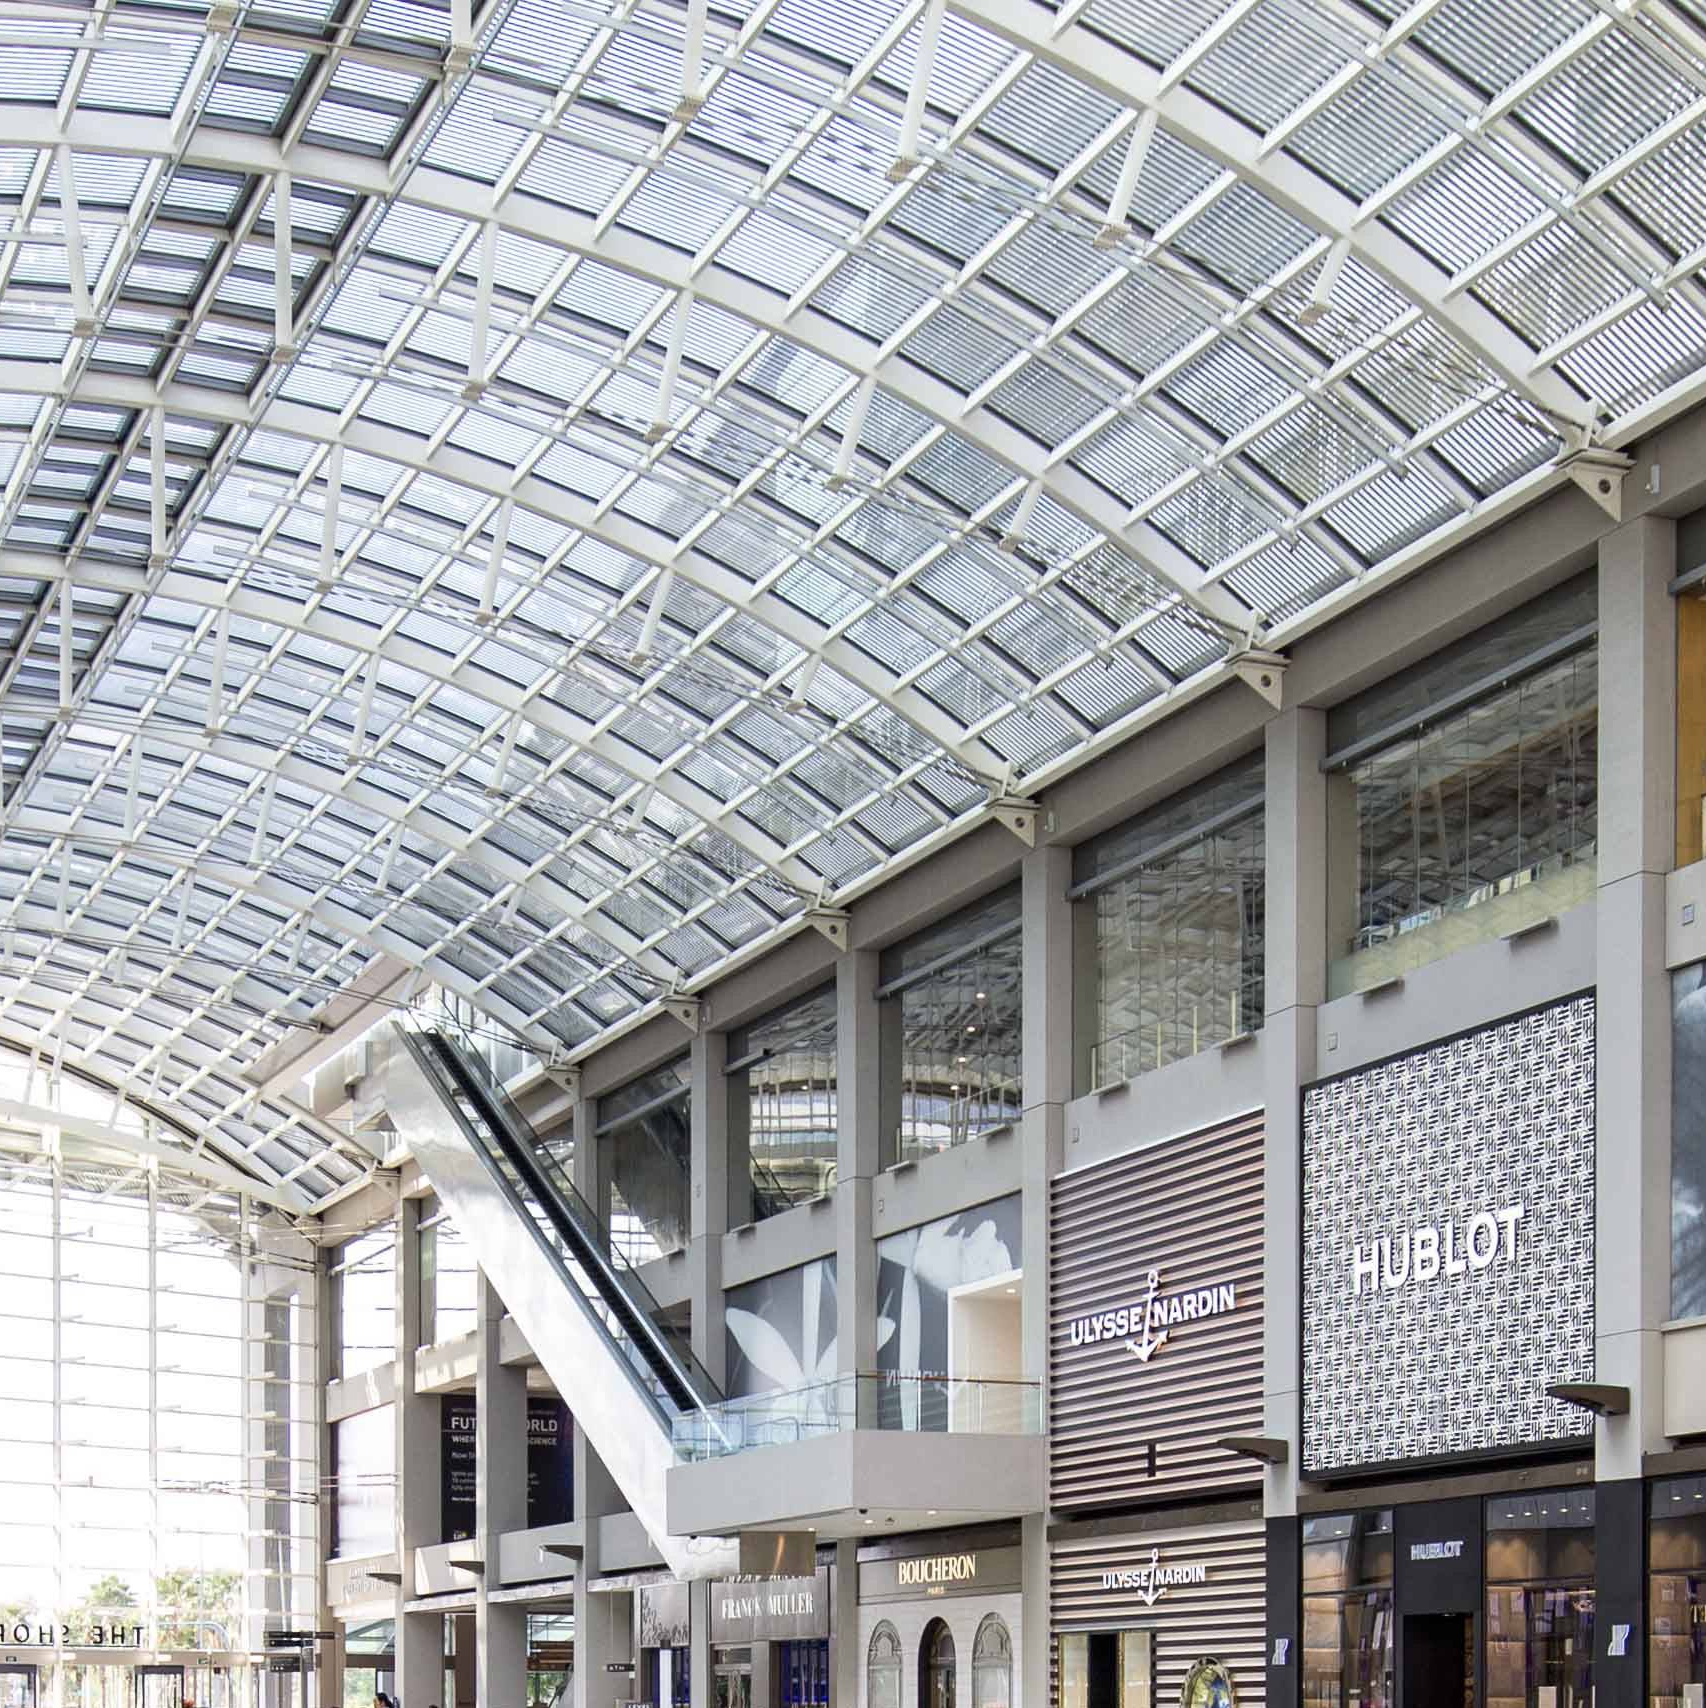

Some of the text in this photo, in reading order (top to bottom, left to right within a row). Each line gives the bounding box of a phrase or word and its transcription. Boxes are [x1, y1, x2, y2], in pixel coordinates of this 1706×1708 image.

[1353, 1204, 1526, 1296] HUBLOT
[1070, 1283, 1237, 1346] ULYSSE NARDIN
[451, 1416, 477, 1430] FUT
[528, 1437, 557, 1446] CIENCE
[1411, 1540, 1464, 1560] HUBLOT
[898, 1554, 976, 1585] BOUCHERON
[1102, 1565, 1206, 1590] ULYSSE NARDIN
[722, 1592, 813, 1619] FRANCK MULLER
